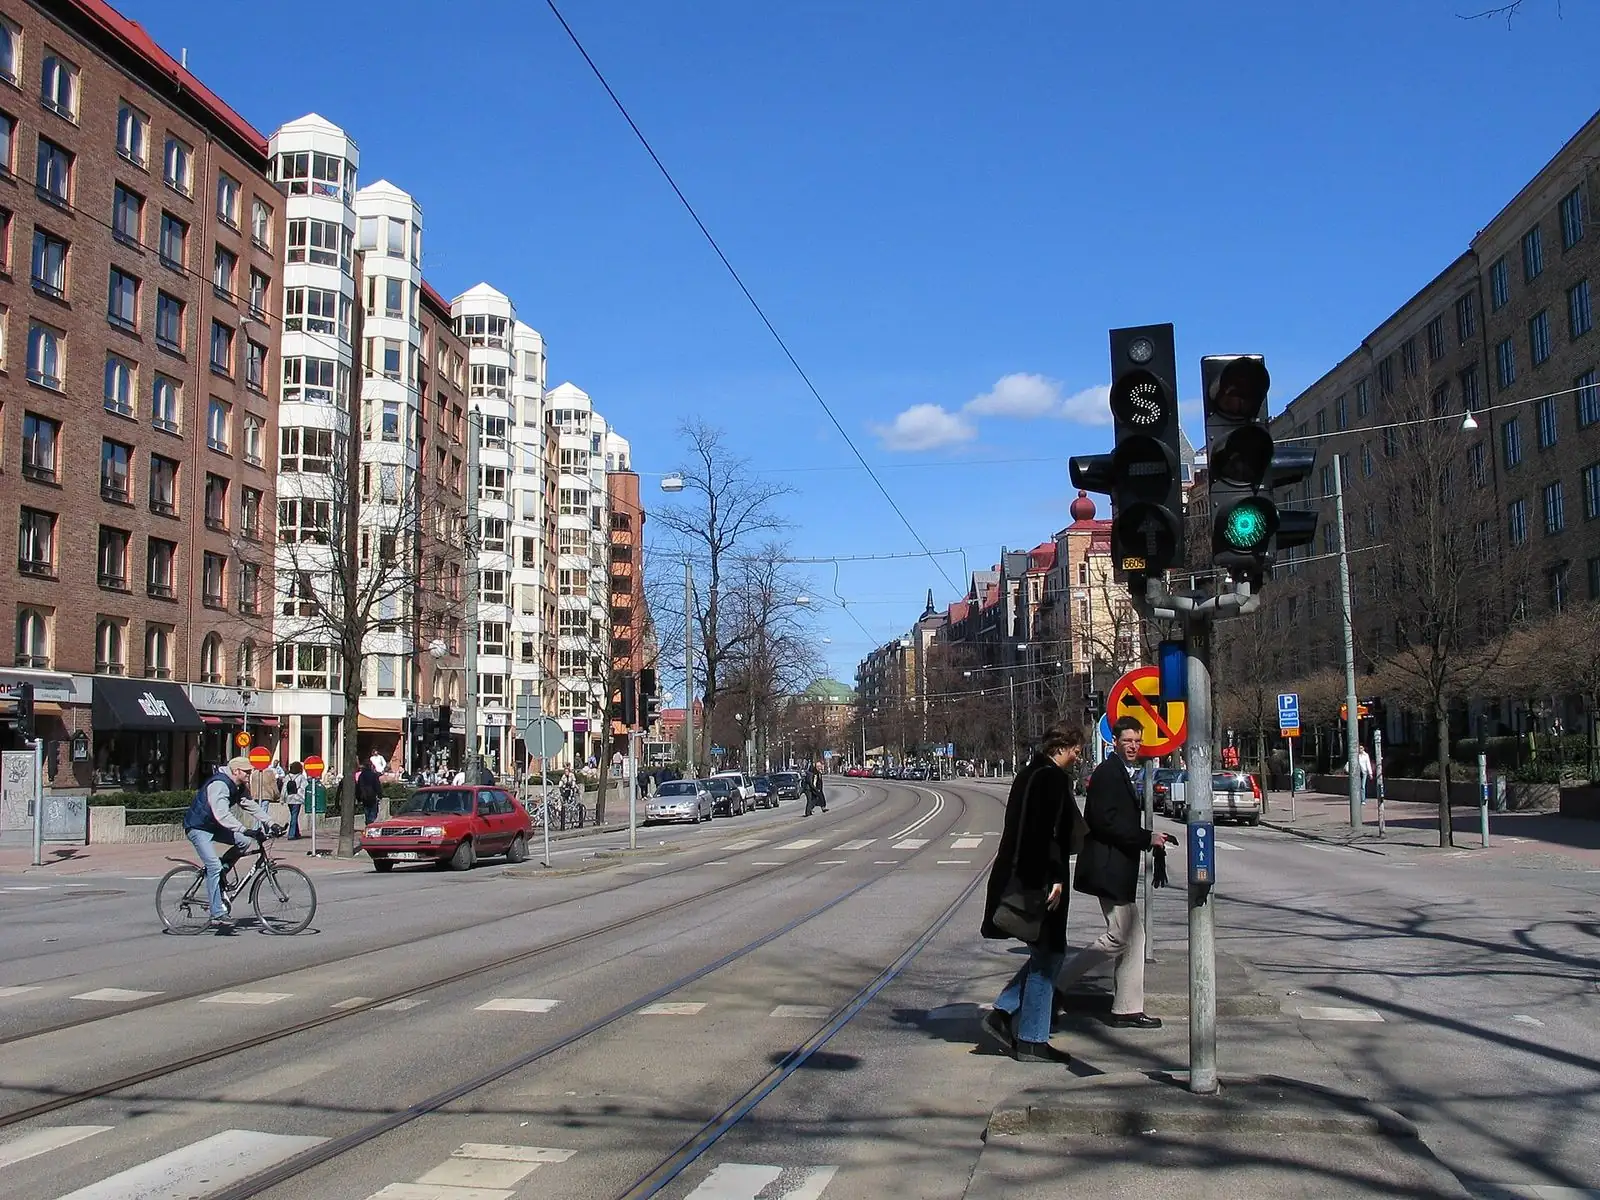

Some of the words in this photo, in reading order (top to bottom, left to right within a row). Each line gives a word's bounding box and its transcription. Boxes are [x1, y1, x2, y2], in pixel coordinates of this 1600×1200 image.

[1129, 383, 1161, 425] S
[1124, 558, 1144, 569] 6605
[1283, 696, 1294, 709] P
